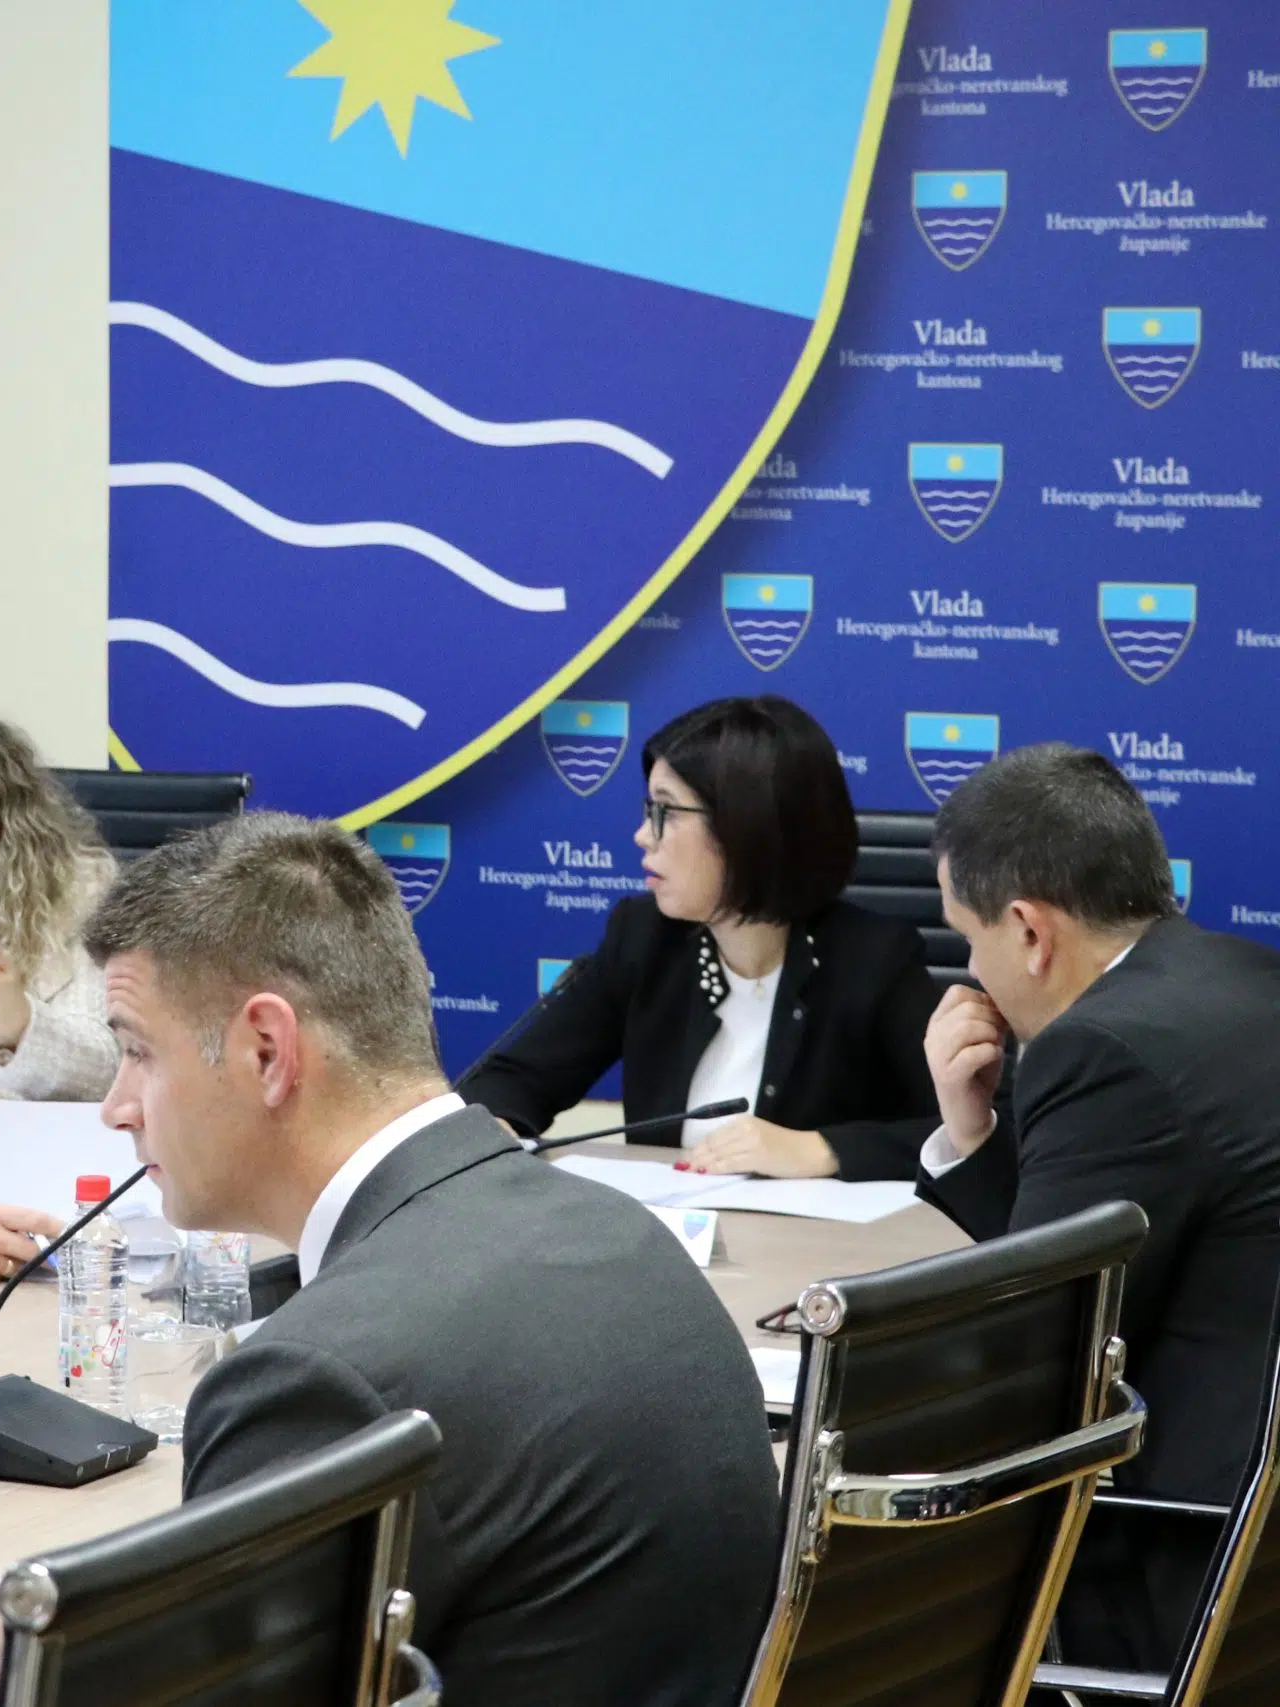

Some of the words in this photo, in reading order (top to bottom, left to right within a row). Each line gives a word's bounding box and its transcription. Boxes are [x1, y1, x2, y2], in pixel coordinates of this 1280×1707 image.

[919, 45, 992, 72] Vlada
[921, 99, 986, 115] kantona
[1117, 180, 1194, 207] Vlada
[1119, 235, 1190, 256] županije
[913, 319, 987, 346] Vlada
[916, 371, 981, 389] kantona
[1112, 457, 1189, 485] Vlada
[1115, 510, 1186, 531] županije
[909, 590, 984, 617] Vlada
[913, 641, 978, 660] kantona
[1107, 732, 1184, 760] Vlada
[543, 840, 613, 868] Vlada
[545, 890, 609, 912] županije
